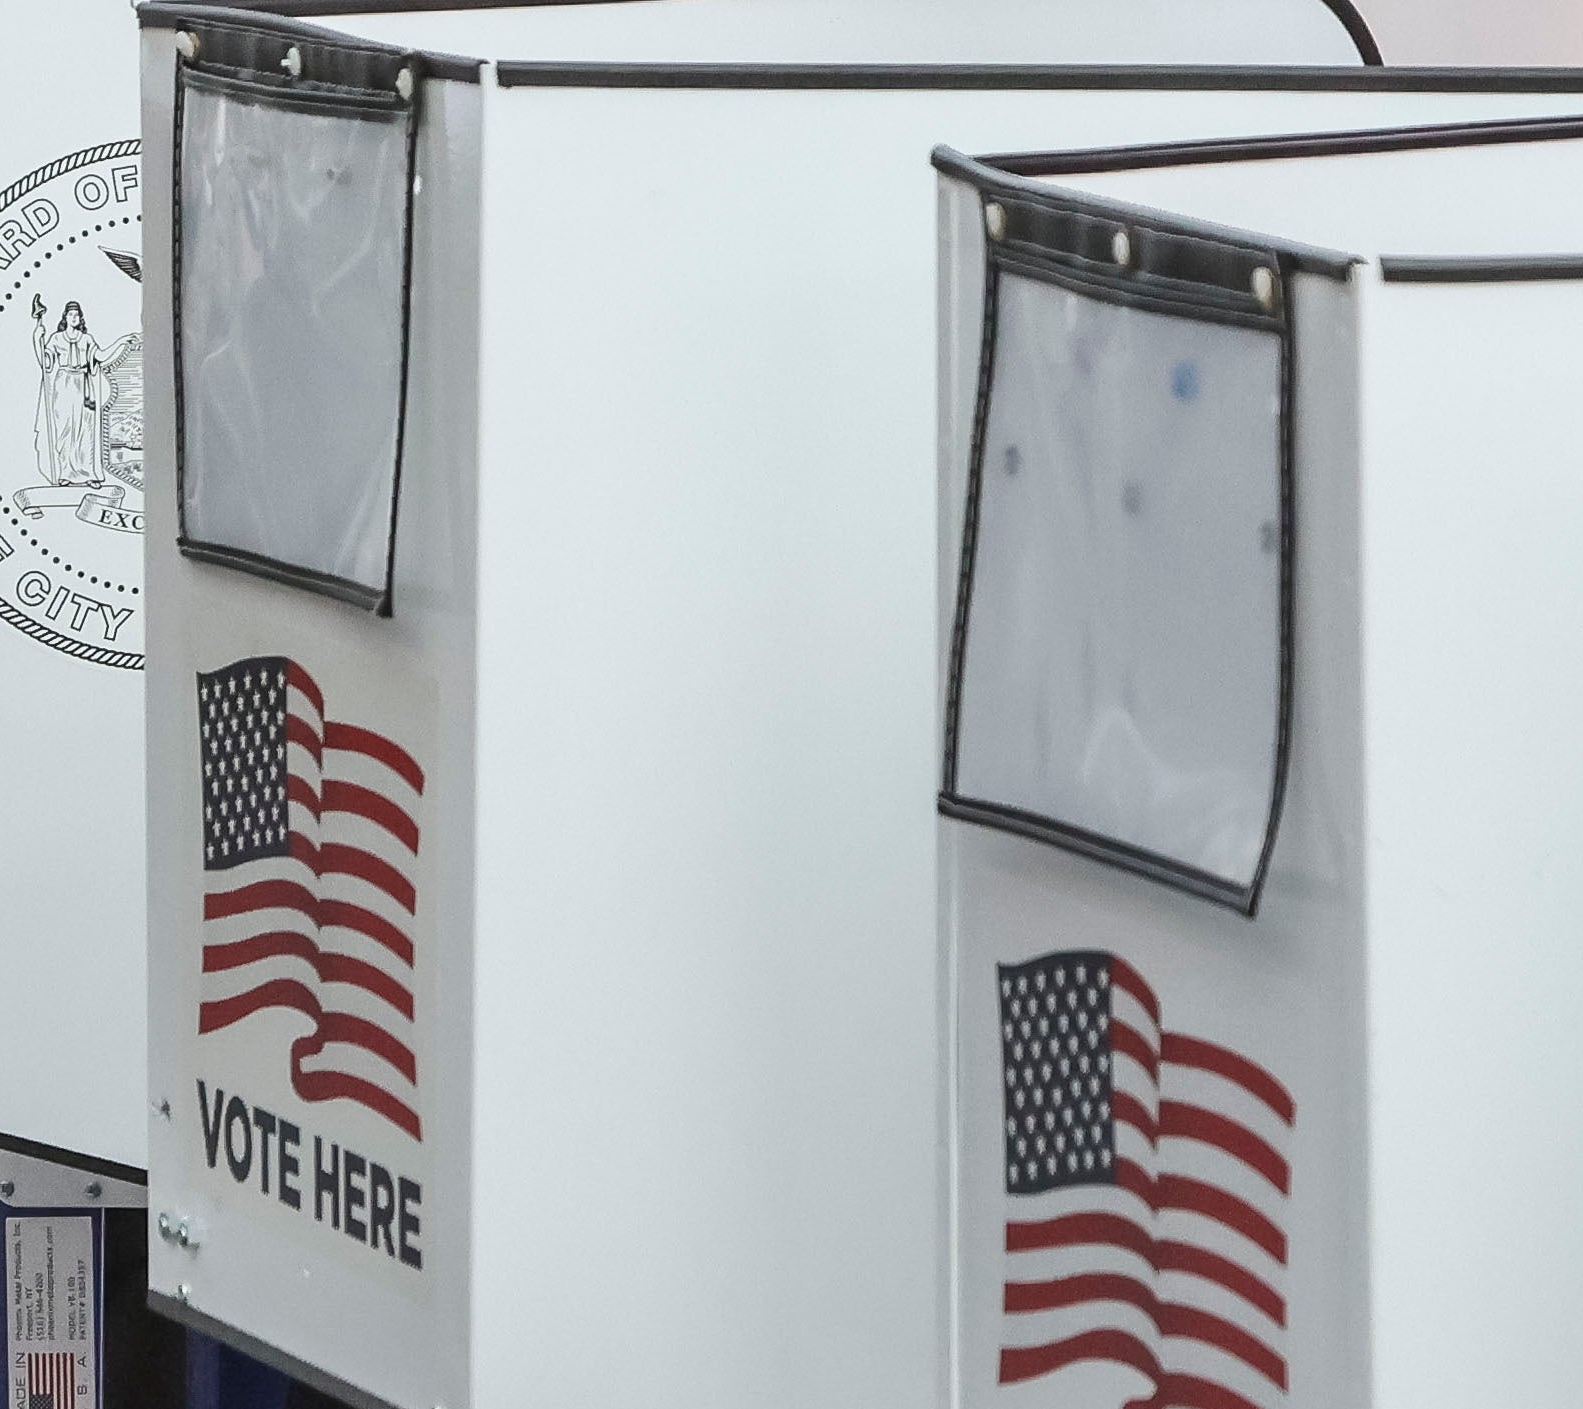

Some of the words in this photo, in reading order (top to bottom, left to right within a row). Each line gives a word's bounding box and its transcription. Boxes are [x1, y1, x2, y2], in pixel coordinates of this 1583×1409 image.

[74, 164, 139, 211] OF
[16, 570, 135, 642] CITY
[196, 1078, 301, 1212] VOTE
[313, 1135, 423, 1272] HERE
[15, 1352, 26, 1369] IN
